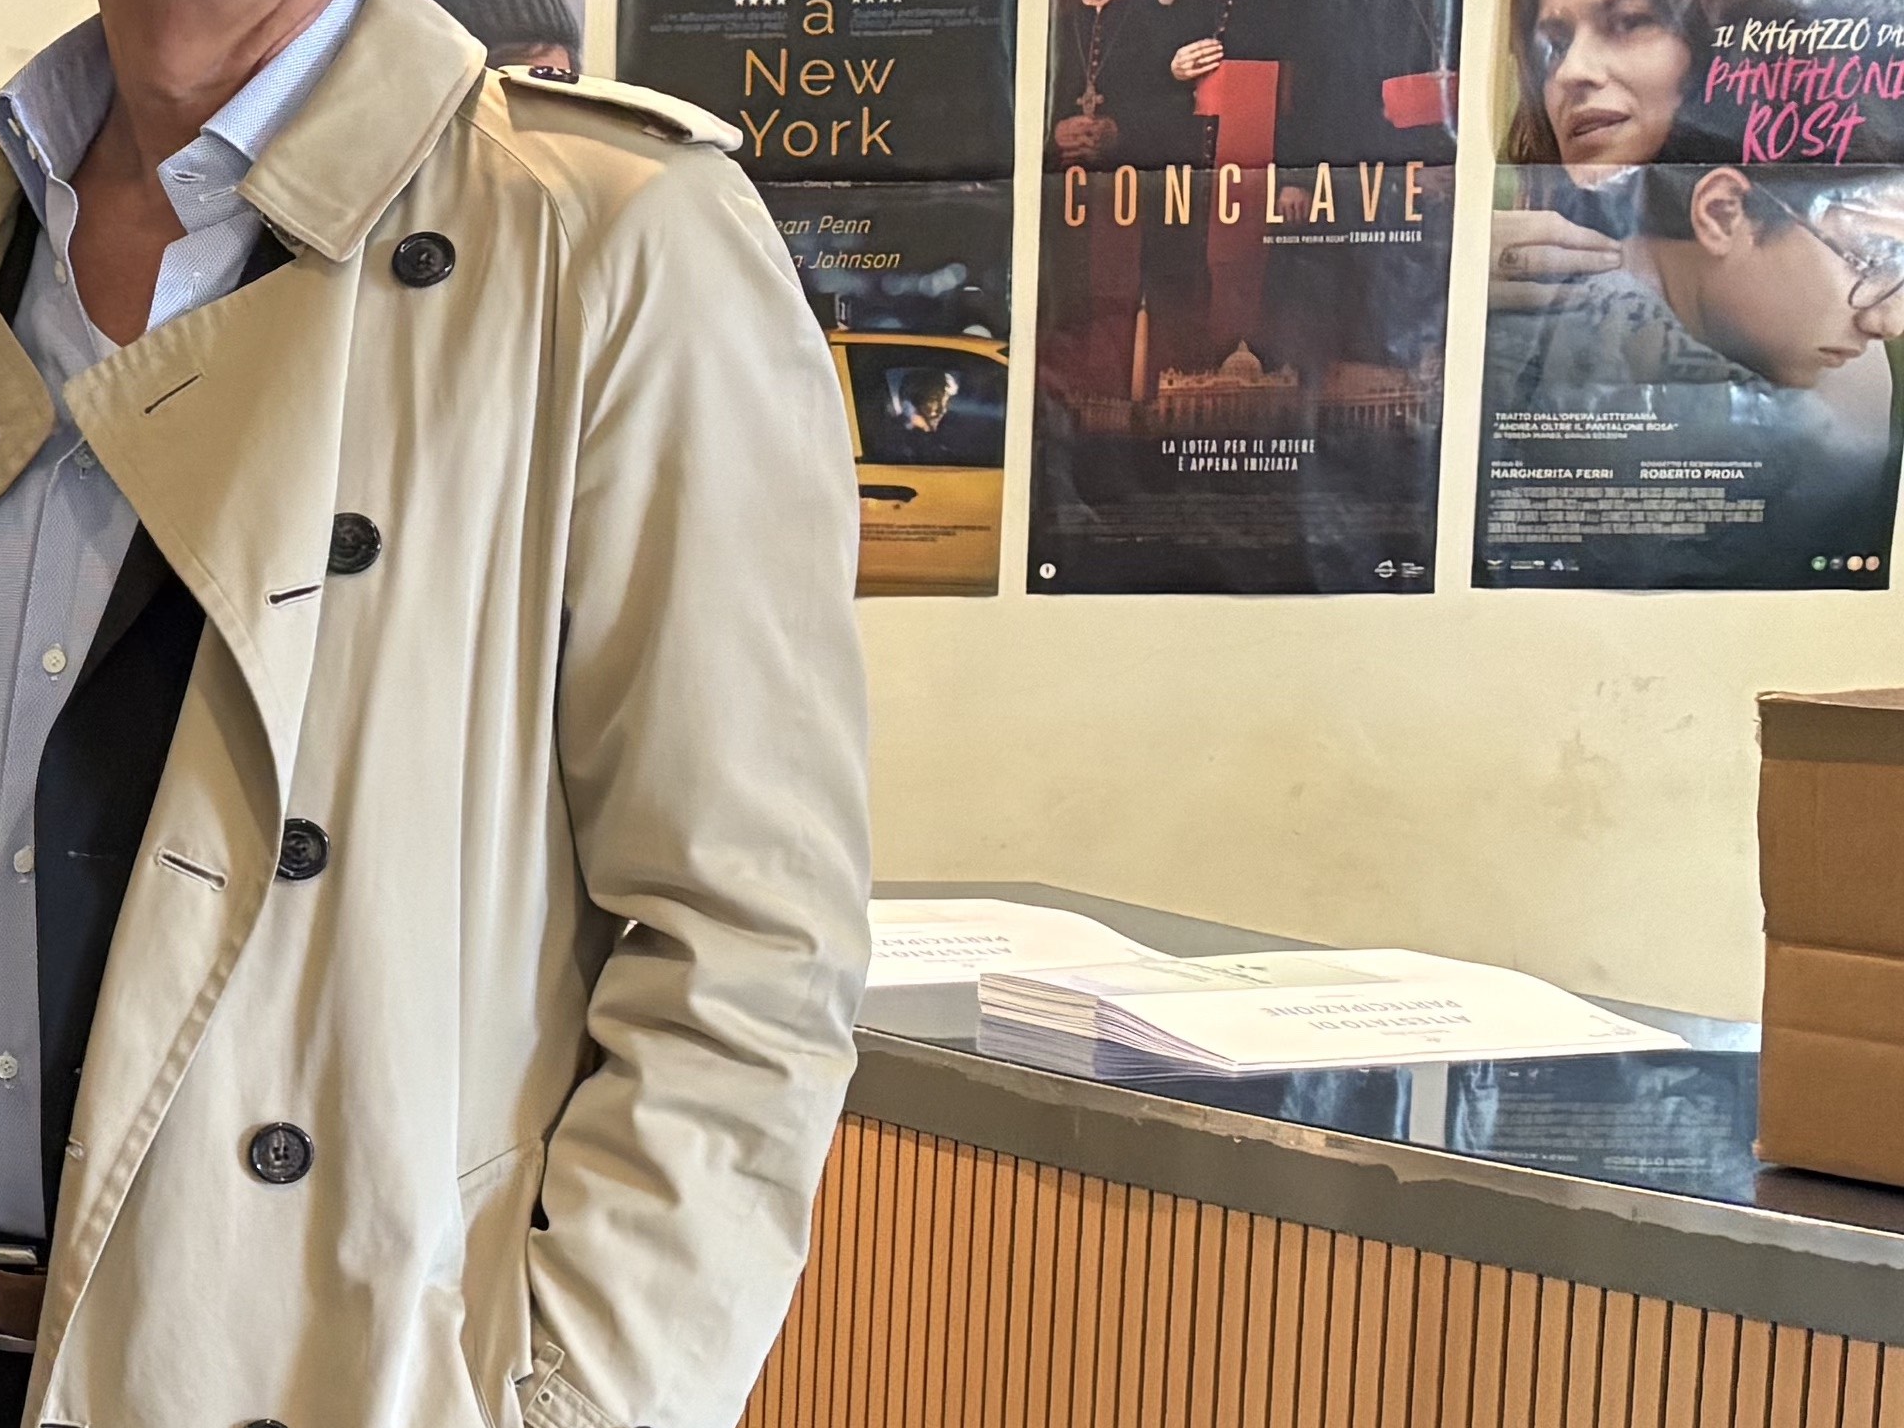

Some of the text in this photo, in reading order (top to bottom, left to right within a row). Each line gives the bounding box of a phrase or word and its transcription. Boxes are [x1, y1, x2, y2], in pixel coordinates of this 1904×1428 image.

[1741, 17, 1871, 55] RAGAZZO
[743, 47, 895, 97] New
[740, 105, 892, 159] York
[1742, 99, 1867, 166] ROSA
[1065, 161, 1424, 227] CONCLAVE
[817, 215, 871, 234] Penn
[808, 250, 900, 270] Johnson
[1162, 438, 1315, 454] LA LOTTA PER IL POTERE
[1190, 458, 1237, 471] APPENA
[1491, 468, 1744, 480] MARGHERITA FERRI ROBERTO PROIA
